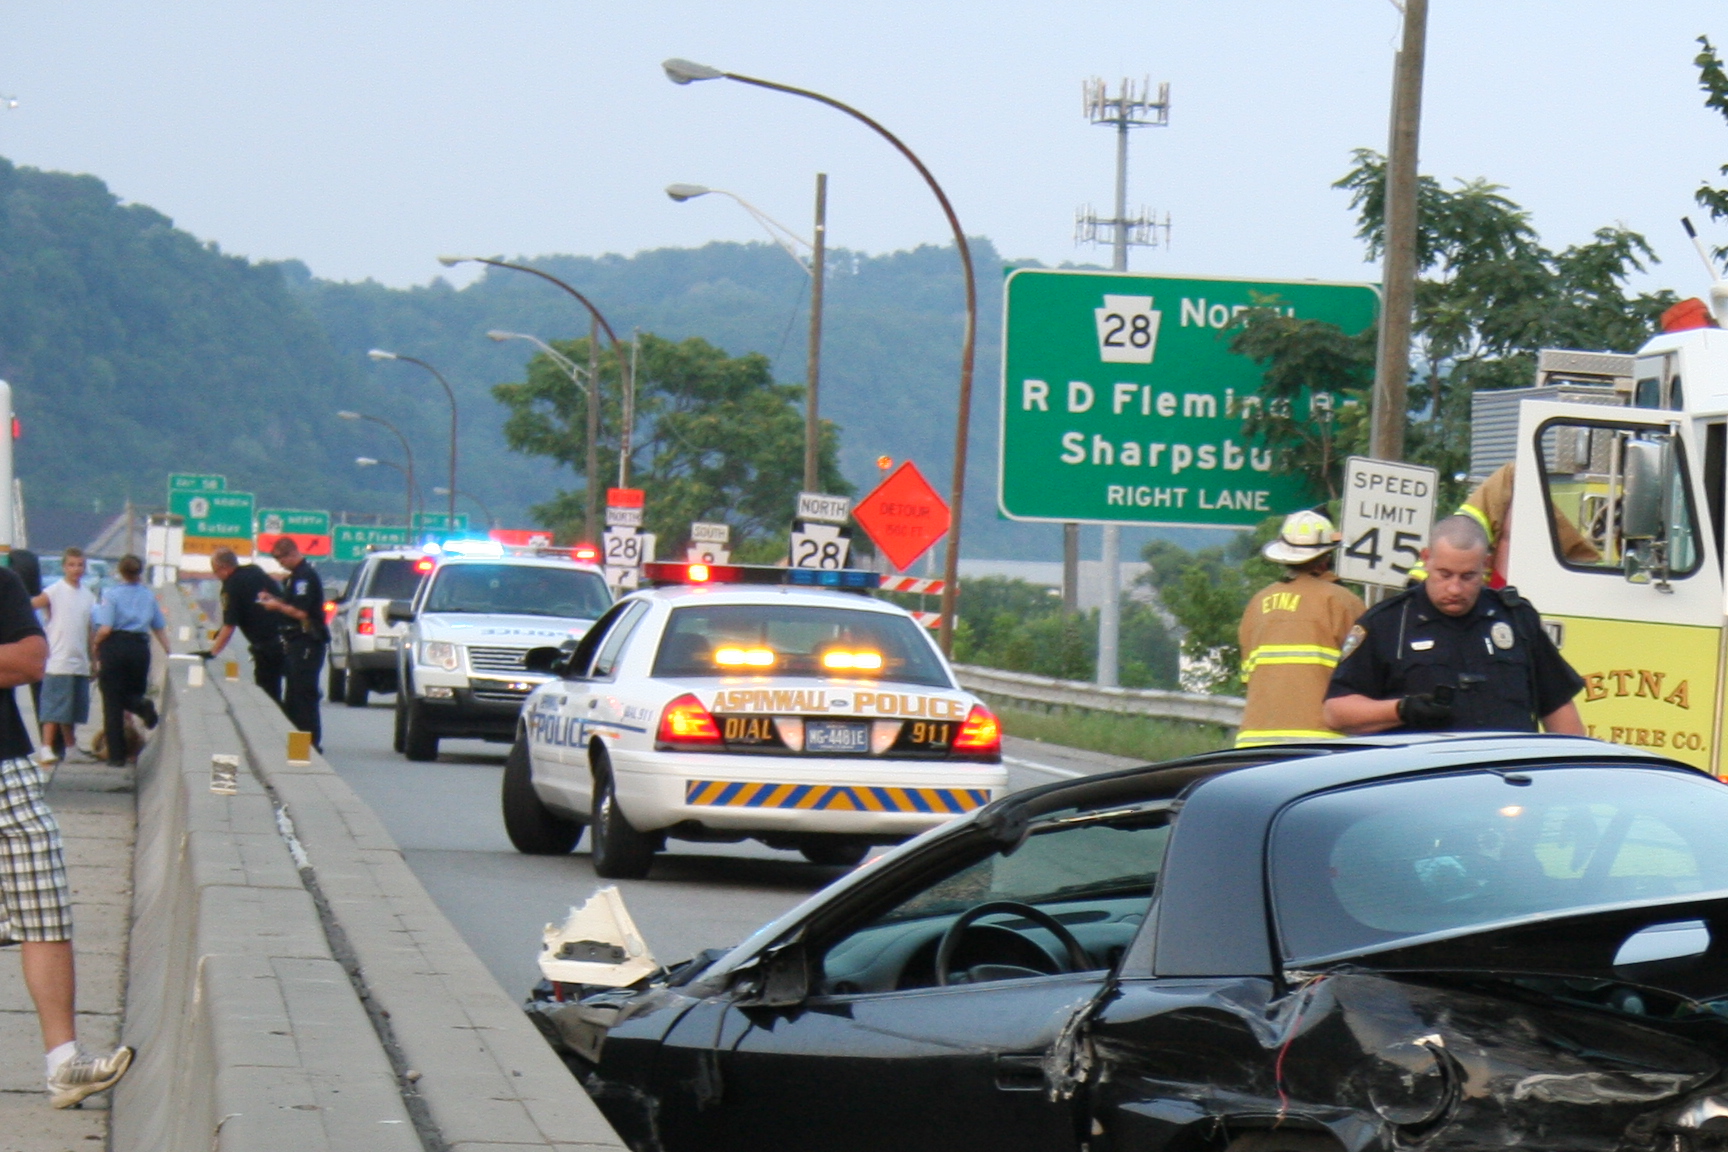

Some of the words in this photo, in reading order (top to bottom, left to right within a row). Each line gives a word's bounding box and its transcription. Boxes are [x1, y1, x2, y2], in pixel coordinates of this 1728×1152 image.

[1103, 313, 1151, 349] 28
[1023, 379, 1049, 412] R
[1067, 381, 1095, 414] D
[1107, 485, 1189, 508] RIGHT
[1198, 489, 1271, 511] LANE
[1354, 472, 1428, 498] SPEED
[607, 509, 641, 520] NORTH
[801, 500, 847, 517] NORTH
[879, 502, 931, 518] DETOUR
[1360, 501, 1417, 525] LIMIT
[694, 526, 726, 539] SOUTH
[609, 536, 638, 559] 28
[799, 539, 840, 568] 28
[1344, 527, 1422, 575] 45
[1262, 592, 1301, 614] ETNA
[1582, 669, 1691, 710] ETNA
[713, 690, 830, 712] ASPINWALL
[852, 691, 967, 719] POLICE
[535, 713, 589, 748] POLICE
[724, 717, 772, 740] DIAL
[912, 722, 949, 744] 911
[1609, 726, 1666, 747] FIRE
[1672, 731, 1707, 752] CO.
